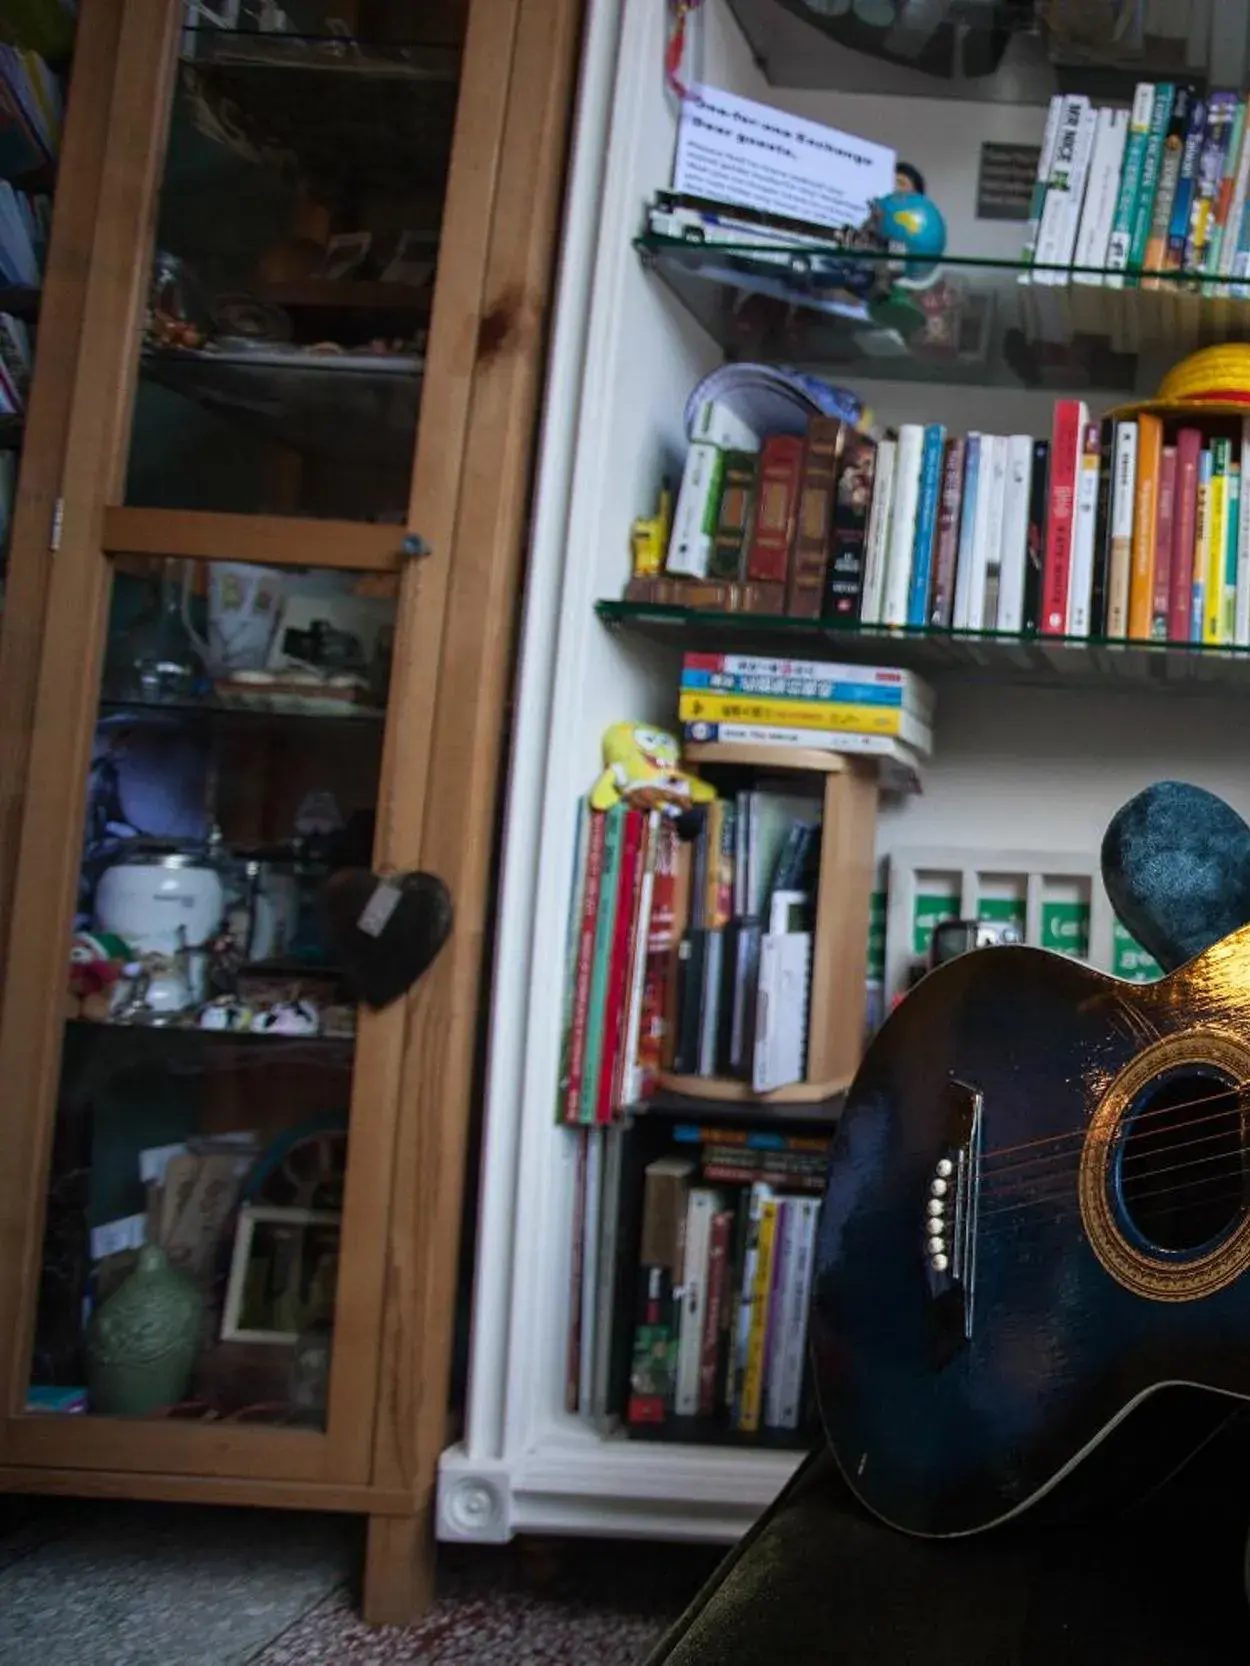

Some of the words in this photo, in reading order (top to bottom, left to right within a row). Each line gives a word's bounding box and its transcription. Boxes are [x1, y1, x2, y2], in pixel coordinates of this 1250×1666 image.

[692, 115, 732, 137] Dear
[1066, 103, 1082, 126] MR
[796, 131, 873, 168] Exchange
